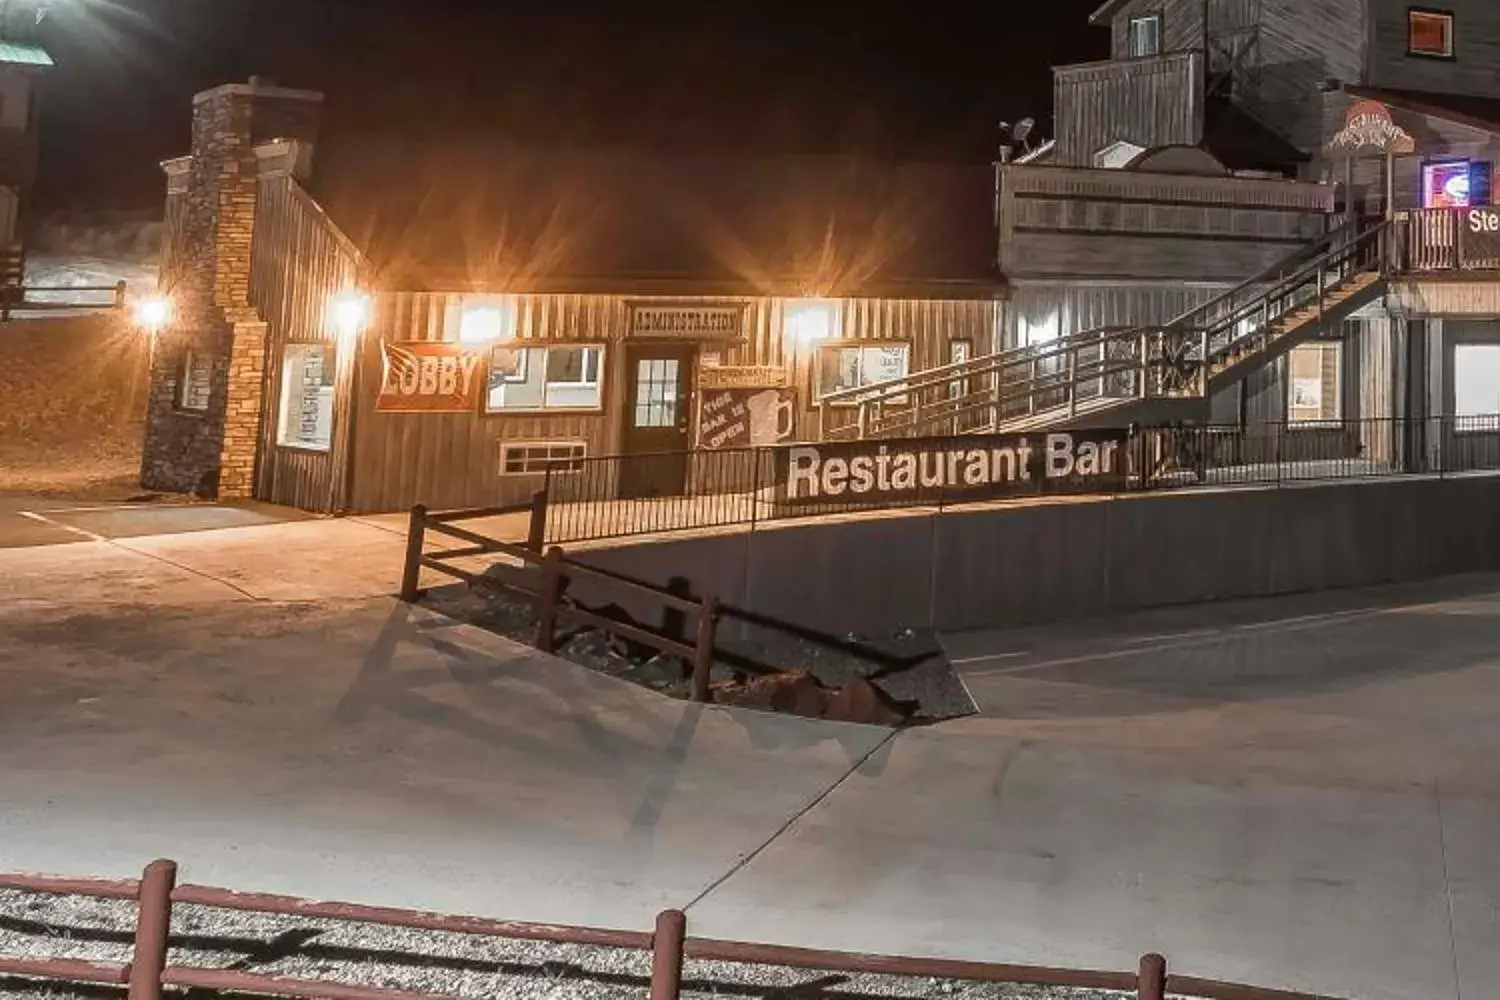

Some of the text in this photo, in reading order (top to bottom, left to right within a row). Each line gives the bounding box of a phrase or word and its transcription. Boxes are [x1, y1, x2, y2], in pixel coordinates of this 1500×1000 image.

[636, 311, 737, 331] ADMINISTRATION
[380, 338, 478, 397] LOBBY
[711, 421, 745, 446] OPEN
[787, 433, 1118, 498] Restaurant Bar
